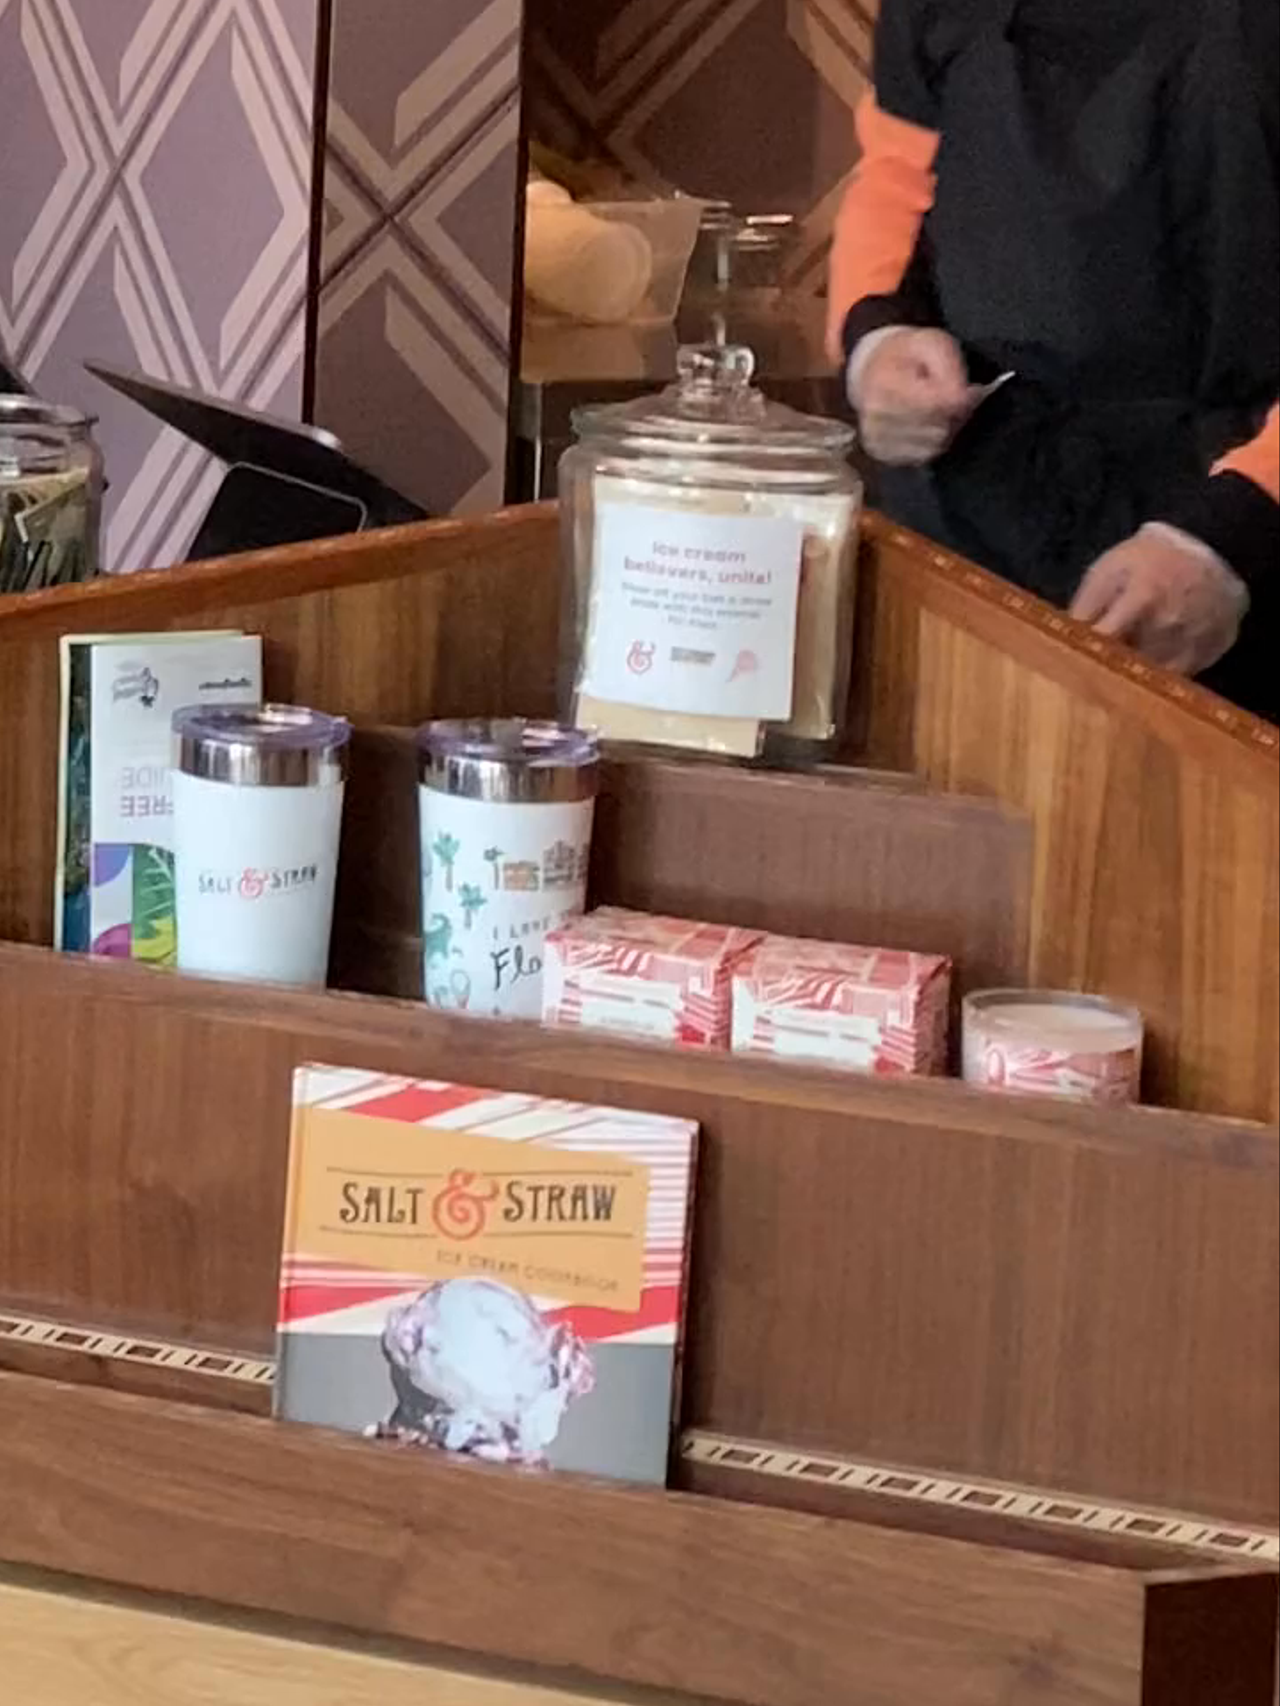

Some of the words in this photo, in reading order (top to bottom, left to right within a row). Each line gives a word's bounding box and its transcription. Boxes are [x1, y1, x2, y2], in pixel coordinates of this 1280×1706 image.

[684, 547, 746, 564] cream
[239, 866, 270, 900] &
[339, 1180, 425, 1225] SALT
[431, 1167, 501, 1242] &
[502, 1179, 617, 1223] STRAW
